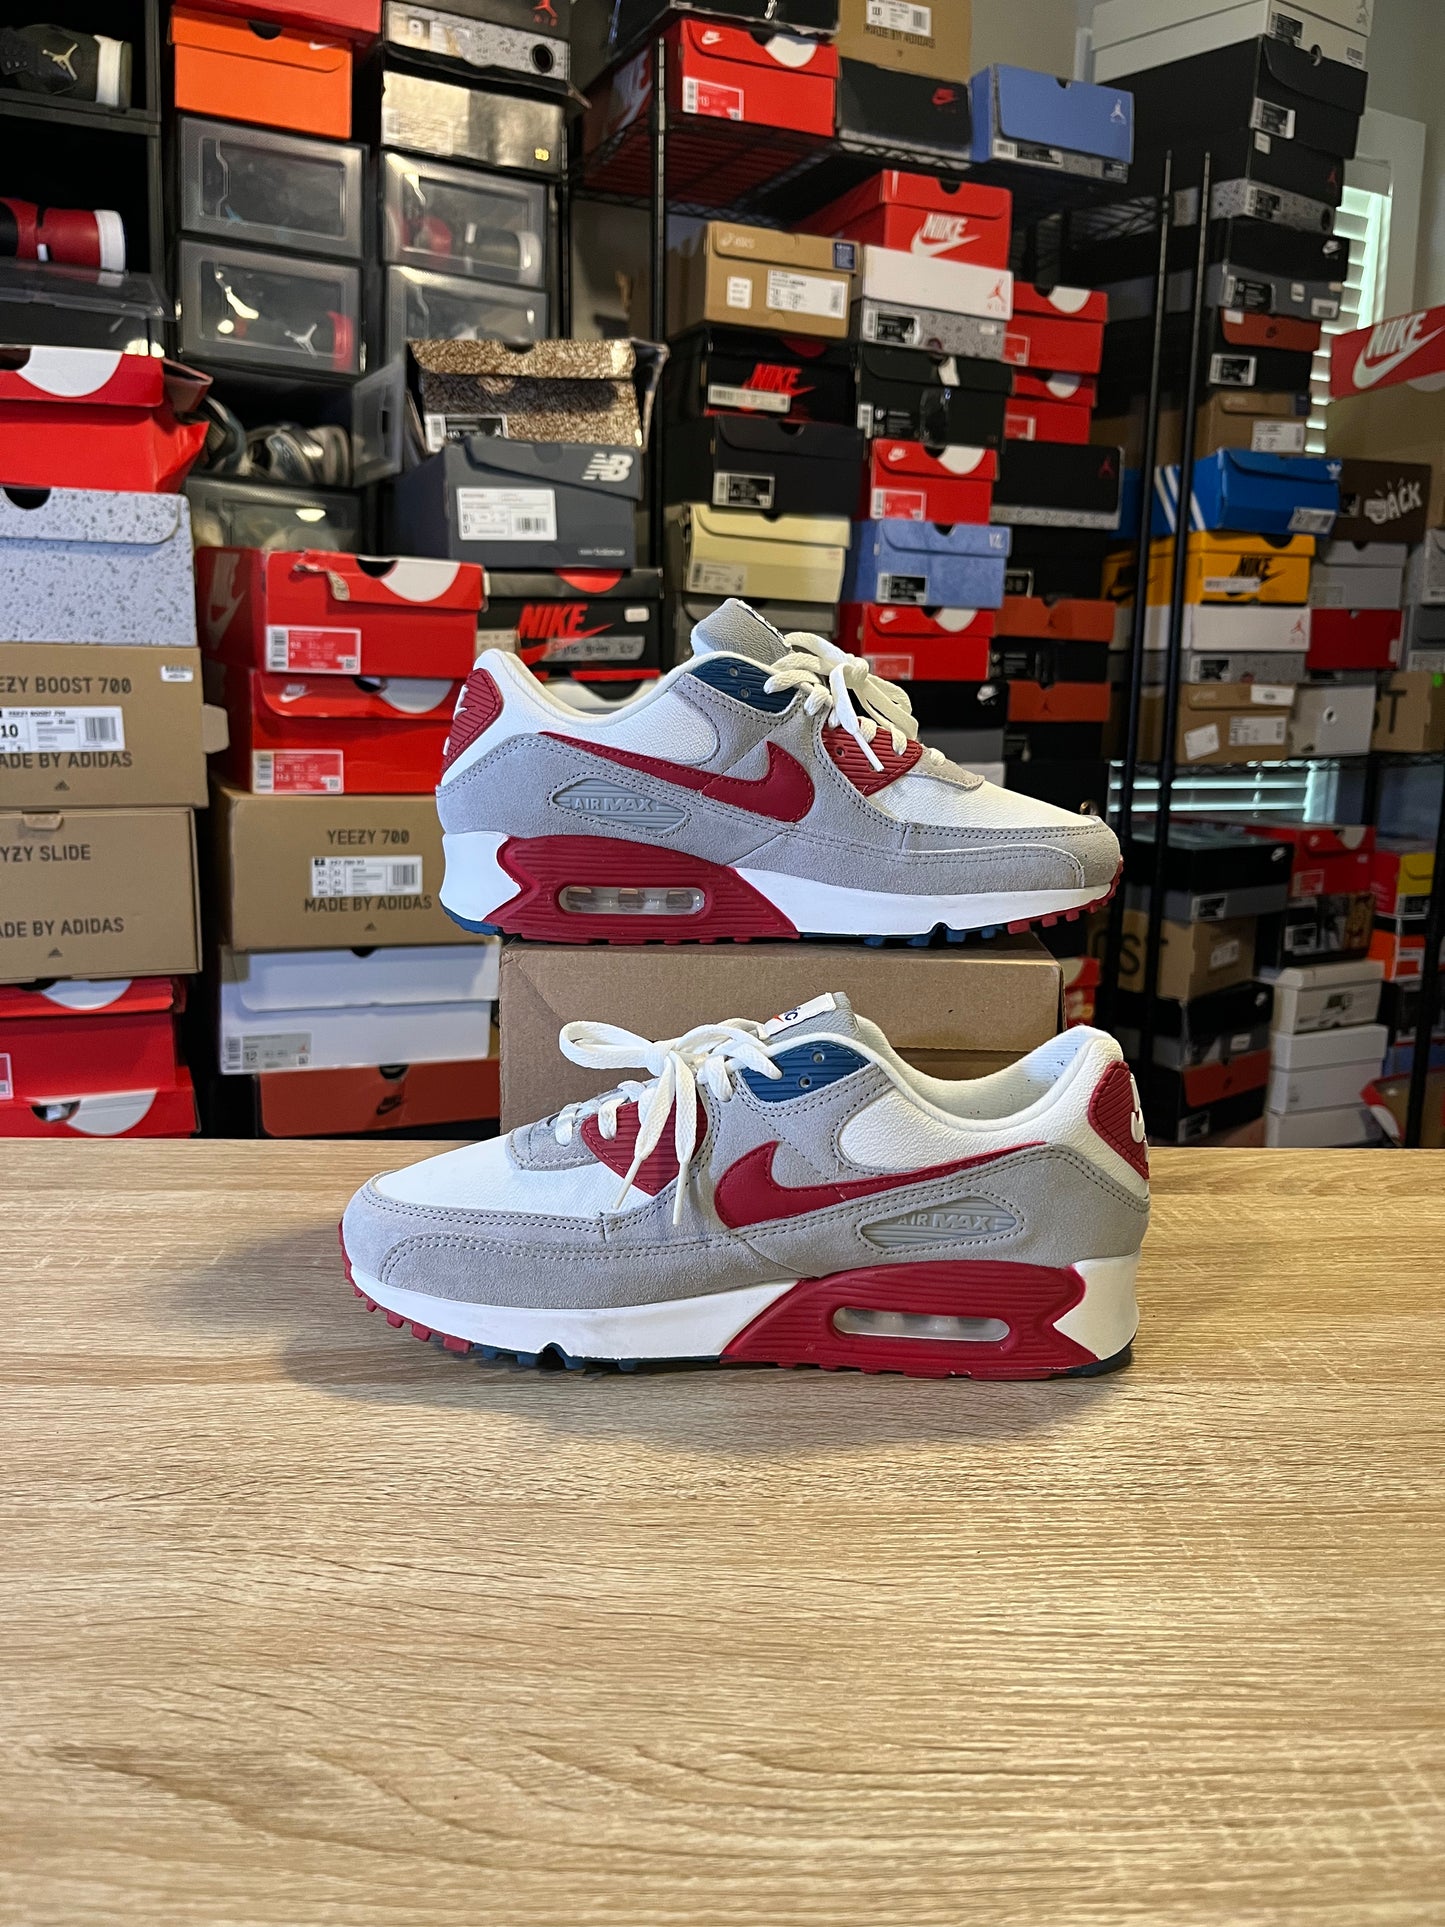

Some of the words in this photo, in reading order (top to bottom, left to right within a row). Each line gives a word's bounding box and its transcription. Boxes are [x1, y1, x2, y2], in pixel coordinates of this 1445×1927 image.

[922, 212, 968, 241] NIKE
[1366, 312, 1427, 359] NIKE
[750, 363, 802, 392] NIKE
[1236, 557, 1274, 579] NIKE
[518, 603, 588, 640] NIKE
[35, 676, 94, 694] BOOST
[99, 678, 132, 694] 700
[1, 723, 19, 738] 10
[39, 752, 63, 769] BY
[68, 751, 133, 768] ADIDAS
[573, 798, 600, 810] AIR
[604, 798, 652, 812] MAX
[327, 829, 376, 845] YEEZY
[382, 829, 410, 844] 700
[40, 844, 91, 862] SLIDE
[304, 897, 349, 912] MADE
[353, 896, 374, 911] BY
[377, 895, 432, 911] ADIDAS
[33, 920, 55, 936] BY
[61, 917, 125, 936] ADIDAS
[898, 1213, 928, 1227] AIR
[932, 1213, 990, 1231] MAX
